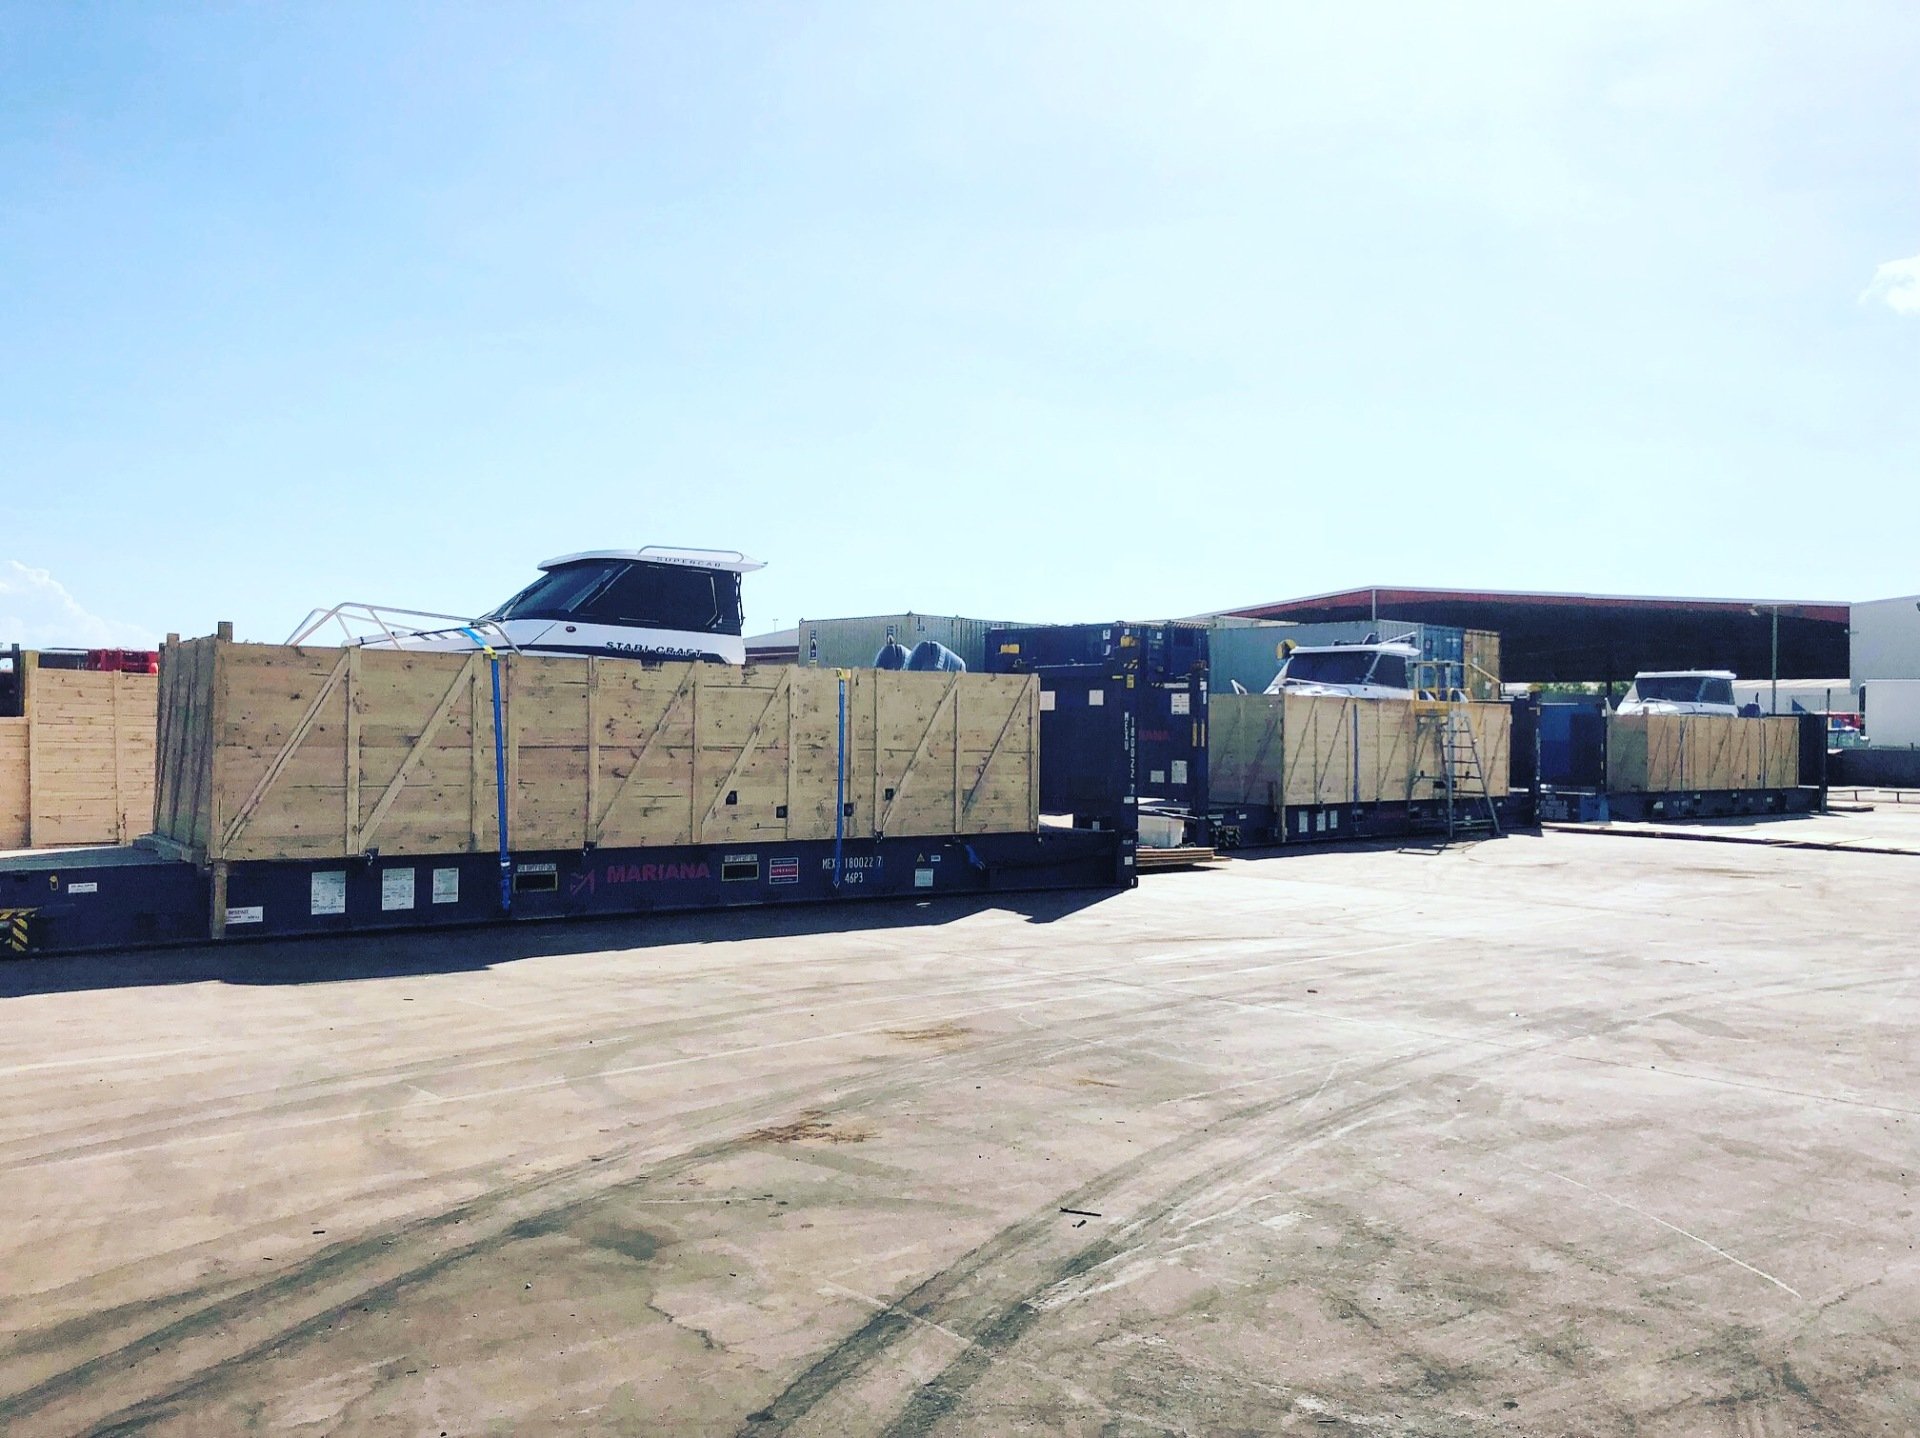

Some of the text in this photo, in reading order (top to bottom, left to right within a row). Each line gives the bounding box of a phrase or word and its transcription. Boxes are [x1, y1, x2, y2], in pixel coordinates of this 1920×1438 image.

[822, 857, 841, 870] MEX
[844, 856, 874, 869] 180022
[607, 863, 711, 883] MARIANA
[844, 871, 864, 884] 46P3
